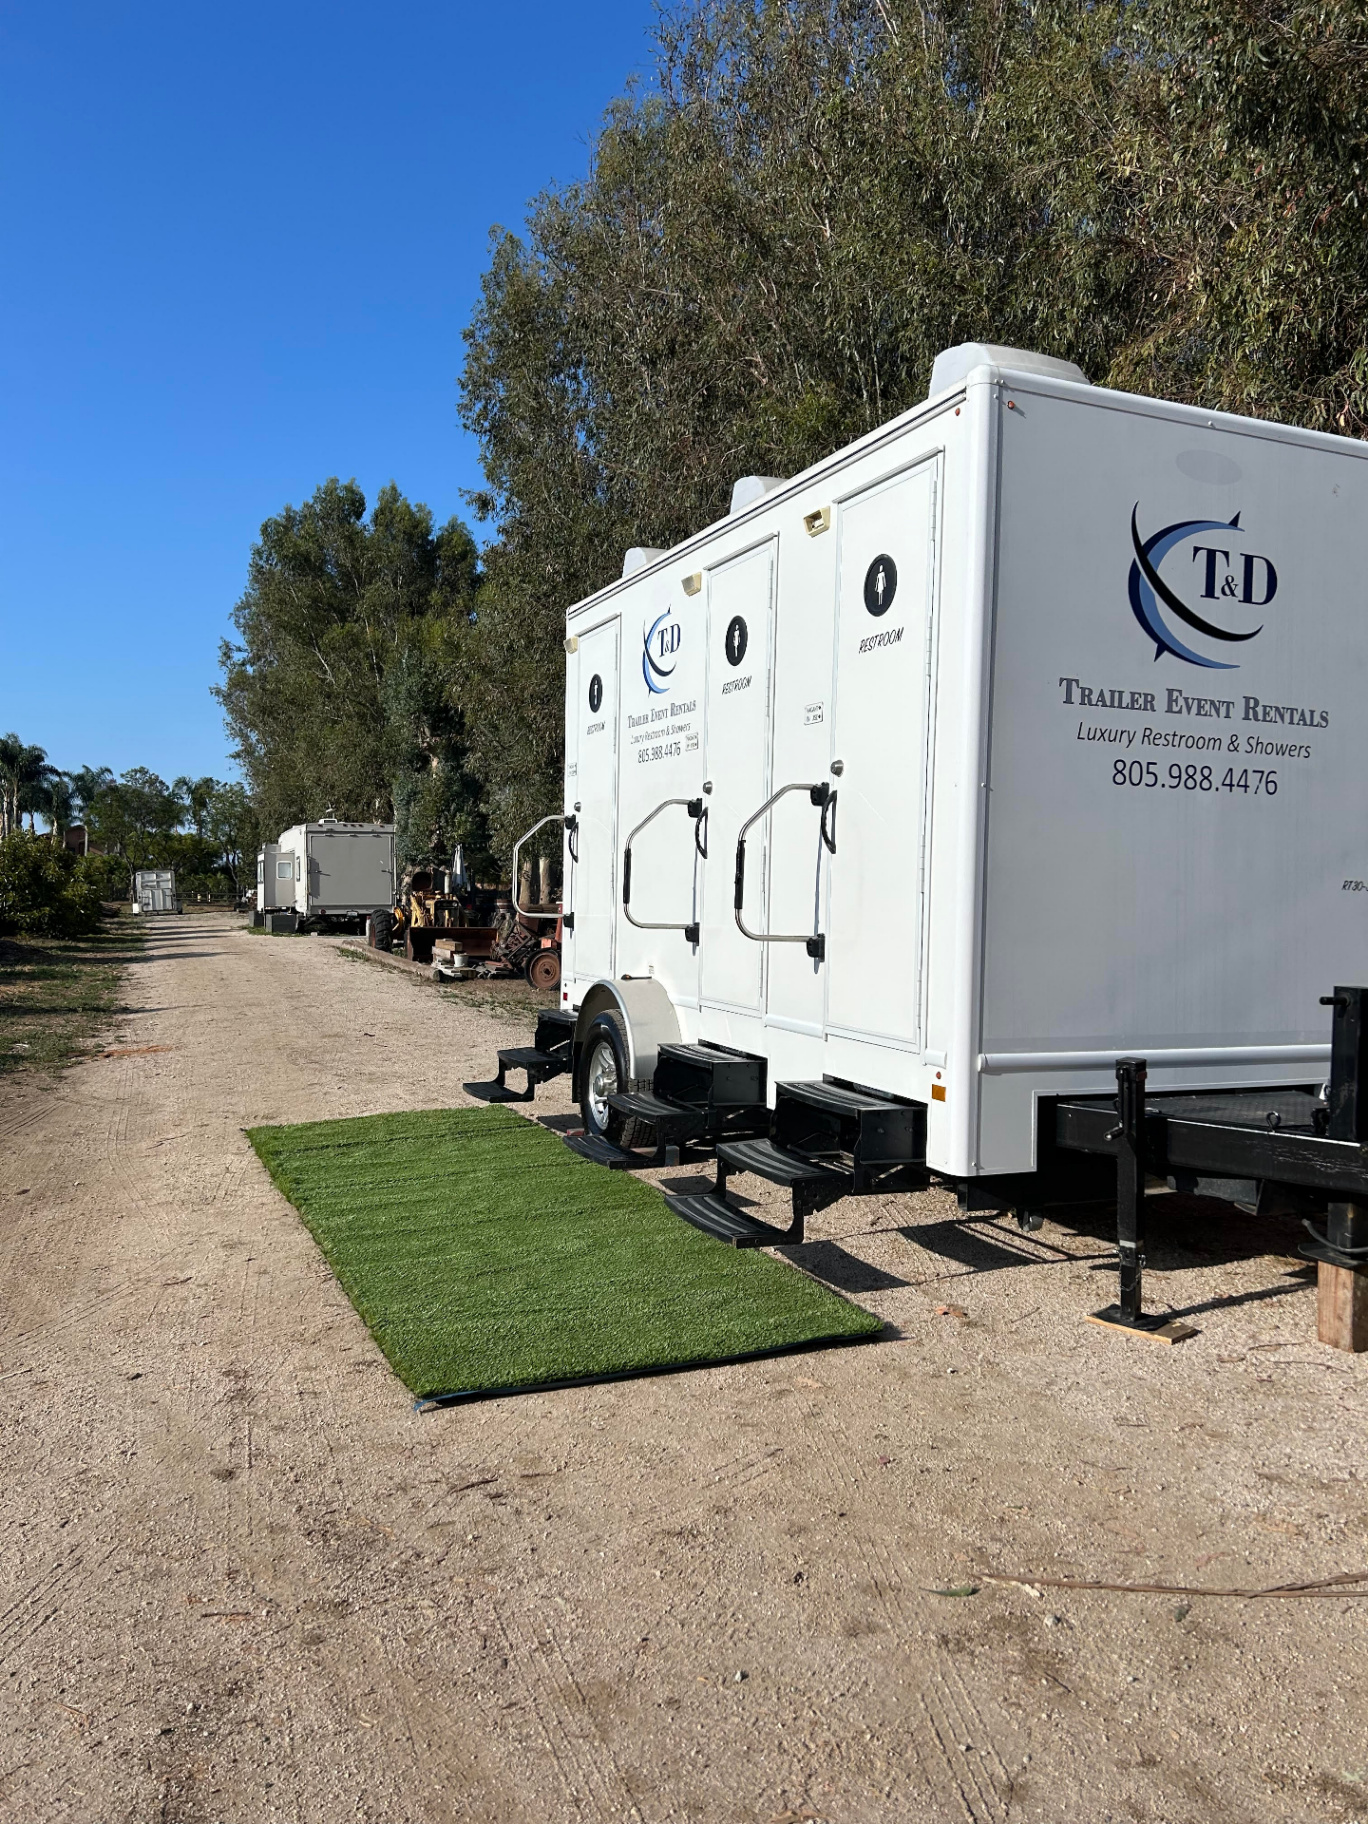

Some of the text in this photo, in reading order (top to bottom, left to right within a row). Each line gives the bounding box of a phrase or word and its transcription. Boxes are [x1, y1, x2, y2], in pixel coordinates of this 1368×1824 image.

[1192, 546, 1278, 605] T&D
[657, 623, 681, 658] T&D
[859, 627, 904, 654] RESTROOM
[722, 675, 752, 695] RESTROOM
[1059, 677, 1329, 728] TRAILER EVENT RENTALS
[627, 700, 697, 729] TRAILER EVENT RENTALS
[671, 722, 691, 735] Showers
[1077, 721, 1312, 759] Luxury Restroom & Showers
[1112, 759, 1278, 796] 805.988.4476
